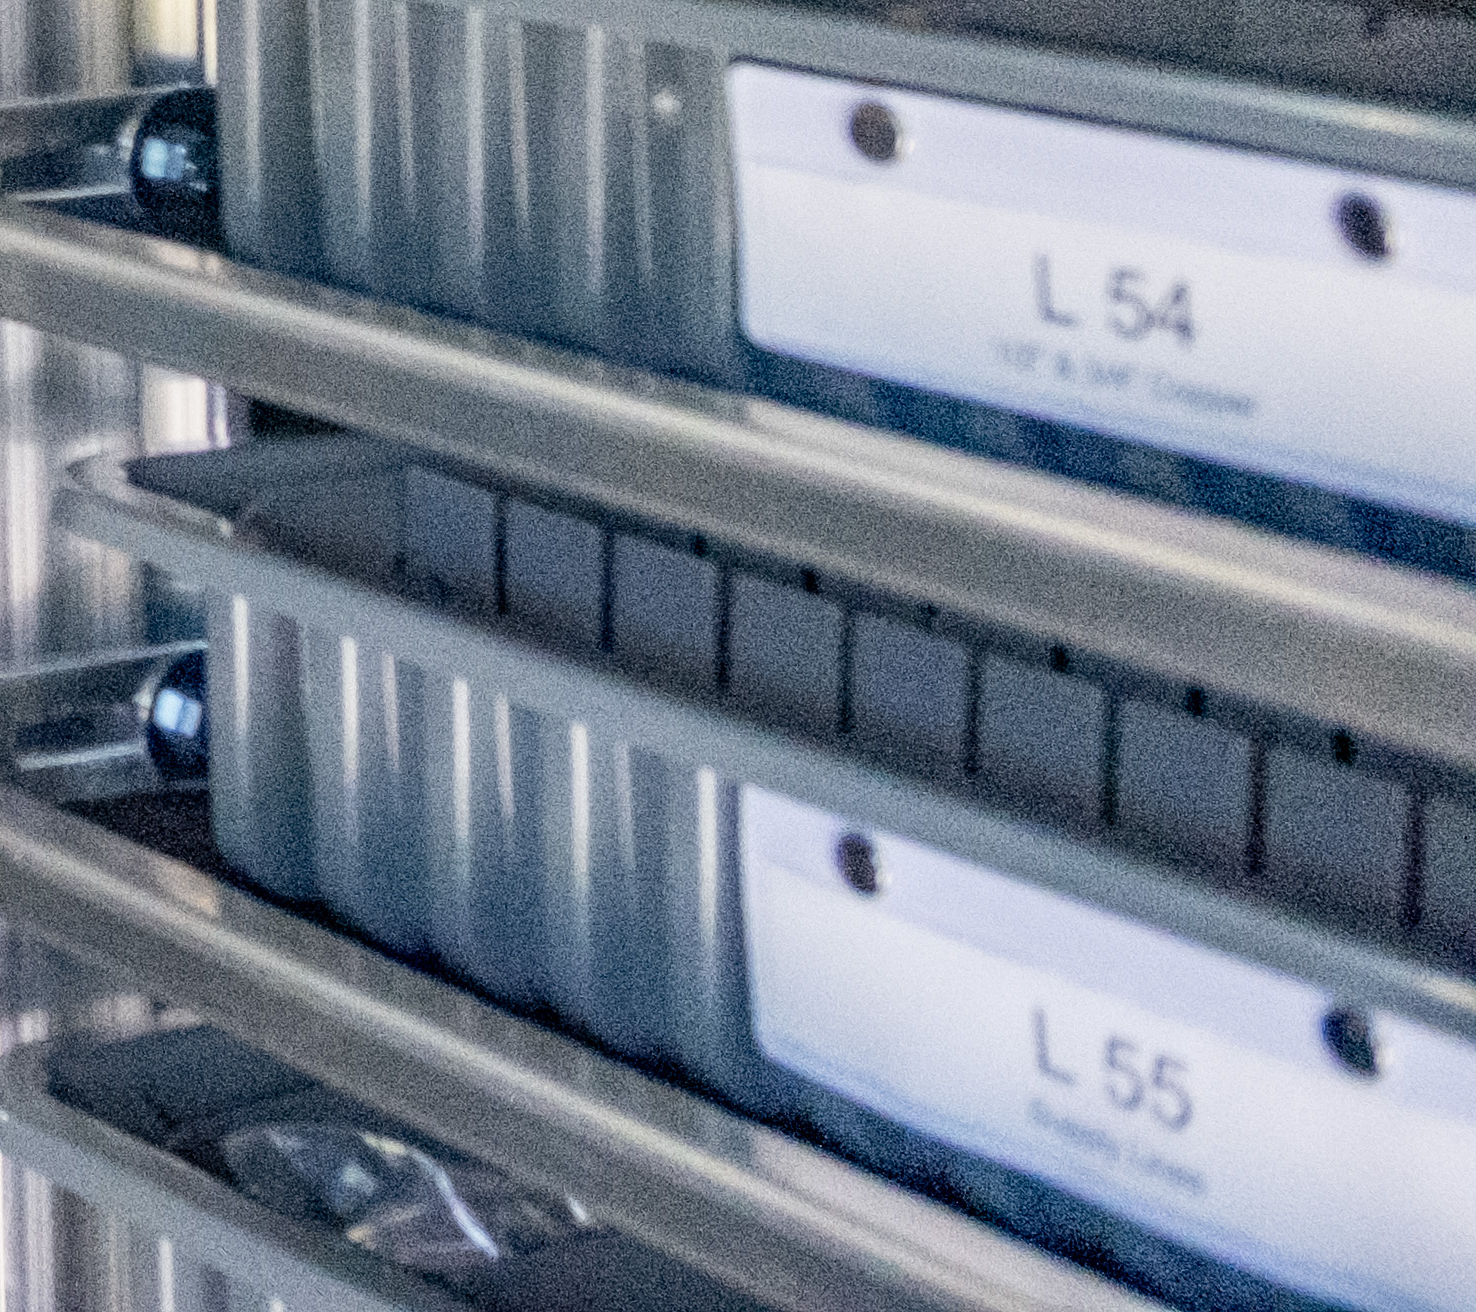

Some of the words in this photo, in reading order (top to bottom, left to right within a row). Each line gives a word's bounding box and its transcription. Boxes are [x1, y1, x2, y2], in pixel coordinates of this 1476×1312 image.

[1032, 250, 1080, 327] L
[1106, 266, 1197, 350] 54
[1033, 1005, 1077, 1087] L
[1104, 1034, 1193, 1133] 55
